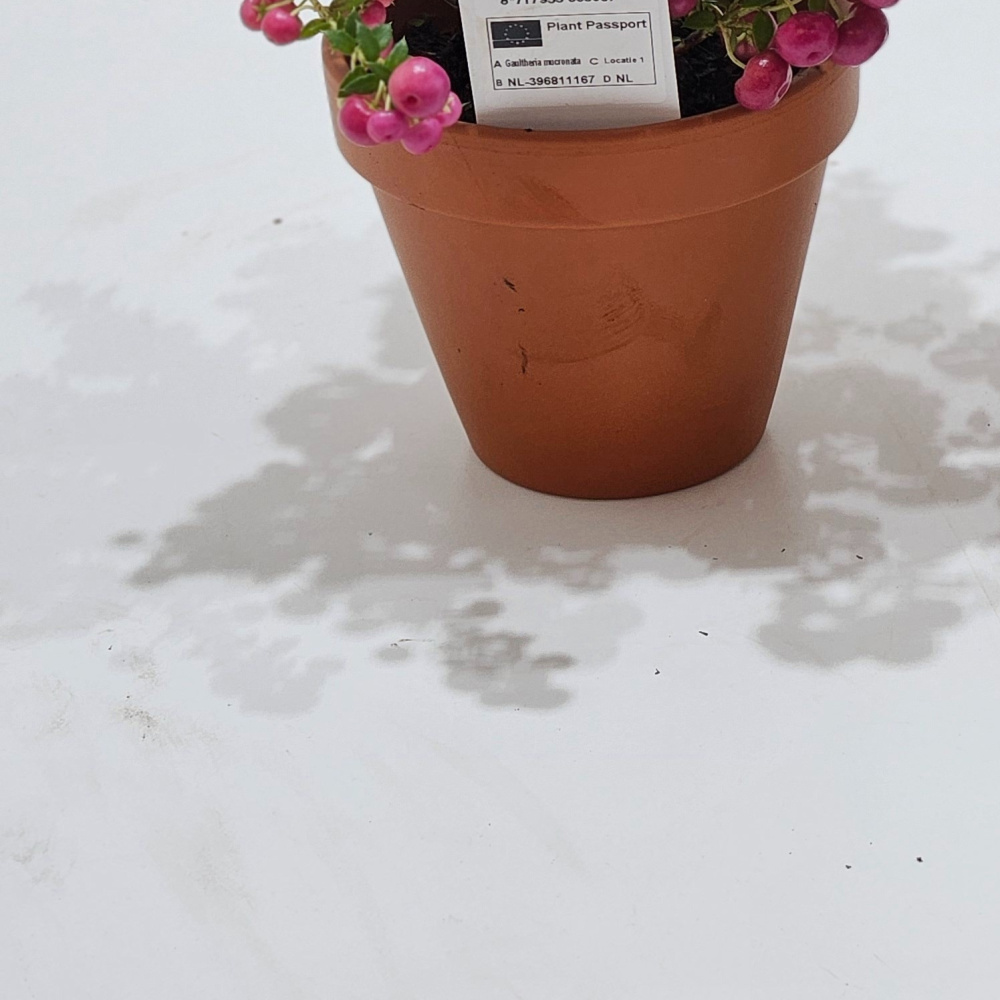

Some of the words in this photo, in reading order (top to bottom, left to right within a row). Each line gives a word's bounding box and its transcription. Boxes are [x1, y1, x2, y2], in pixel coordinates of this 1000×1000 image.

[547, 21, 582, 31] Plant
[586, 20, 647, 31] Passport
[505, 59, 542, 67] Gaultheria
[508, 76, 595, 87] NL-396811167
